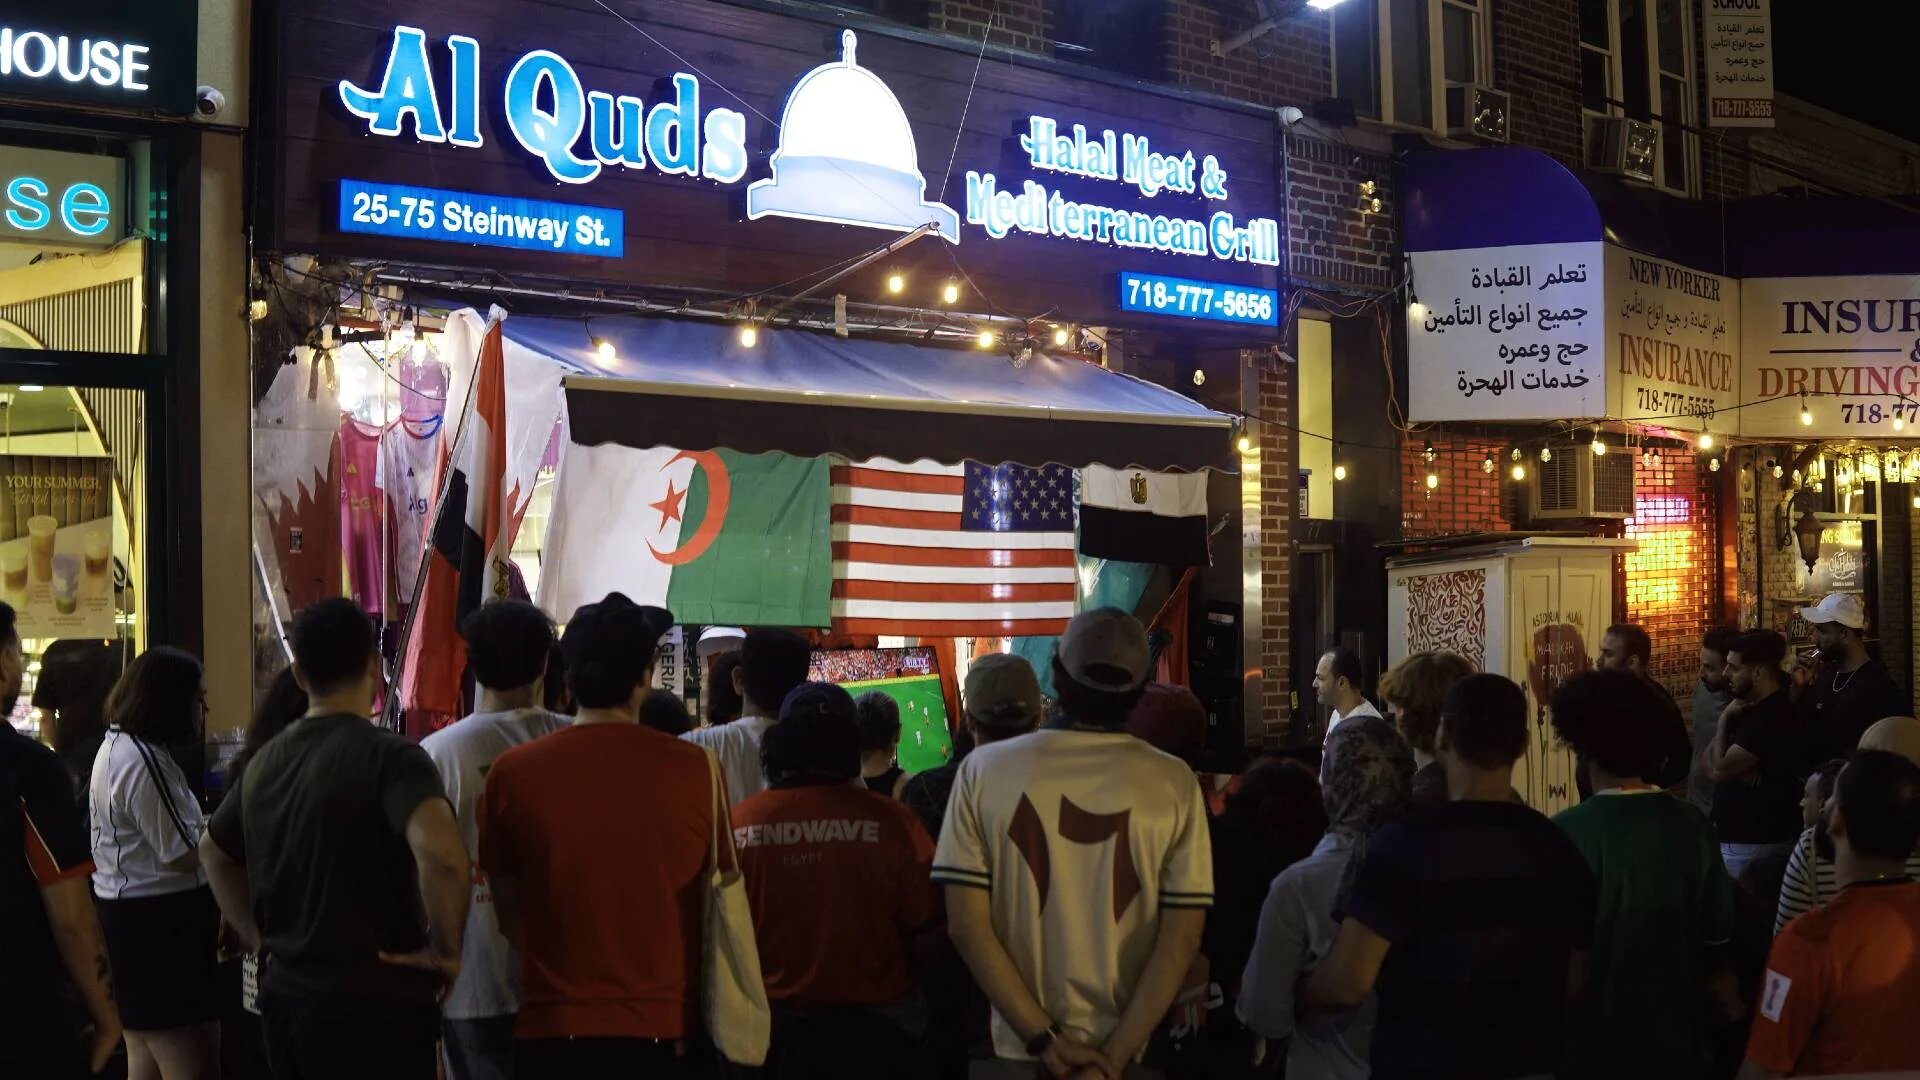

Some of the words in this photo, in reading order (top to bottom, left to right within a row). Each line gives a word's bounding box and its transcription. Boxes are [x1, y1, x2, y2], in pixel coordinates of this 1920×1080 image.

[339, 25, 483, 148] Al
[505, 50, 747, 184] Quds
[1021, 115, 1118, 180] Halal
[1123, 133, 1196, 198] Meat
[1201, 155, 1228, 200] &
[353, 192, 435, 229] 25-75
[443, 205, 569, 248] Steinway
[575, 219, 611, 247] St.
[1210, 211, 1280, 267] Grill
[1539, 263, 1587, 290] تعلم
[1629, 256, 1661, 288] NEW
[1665, 265, 1720, 302] YORKER
[1128, 279, 1272, 320] 718-777-5656
[1424, 298, 1481, 333] التأمين
[1488, 302, 1530, 333] انواع
[1538, 306, 1588, 330] جميع
[1499, 343, 1550, 364] وعمره
[1557, 342, 1589, 365] حج
[1619, 332, 1732, 393] INSURANCE
[1521, 368, 1590, 389] خدمات
[1757, 366, 1920, 397] DRIVING
[1638, 387, 1715, 420] 718-777-5555
[6, 475, 42, 489] YOUR
[733, 818, 880, 849] SENDWAVE
